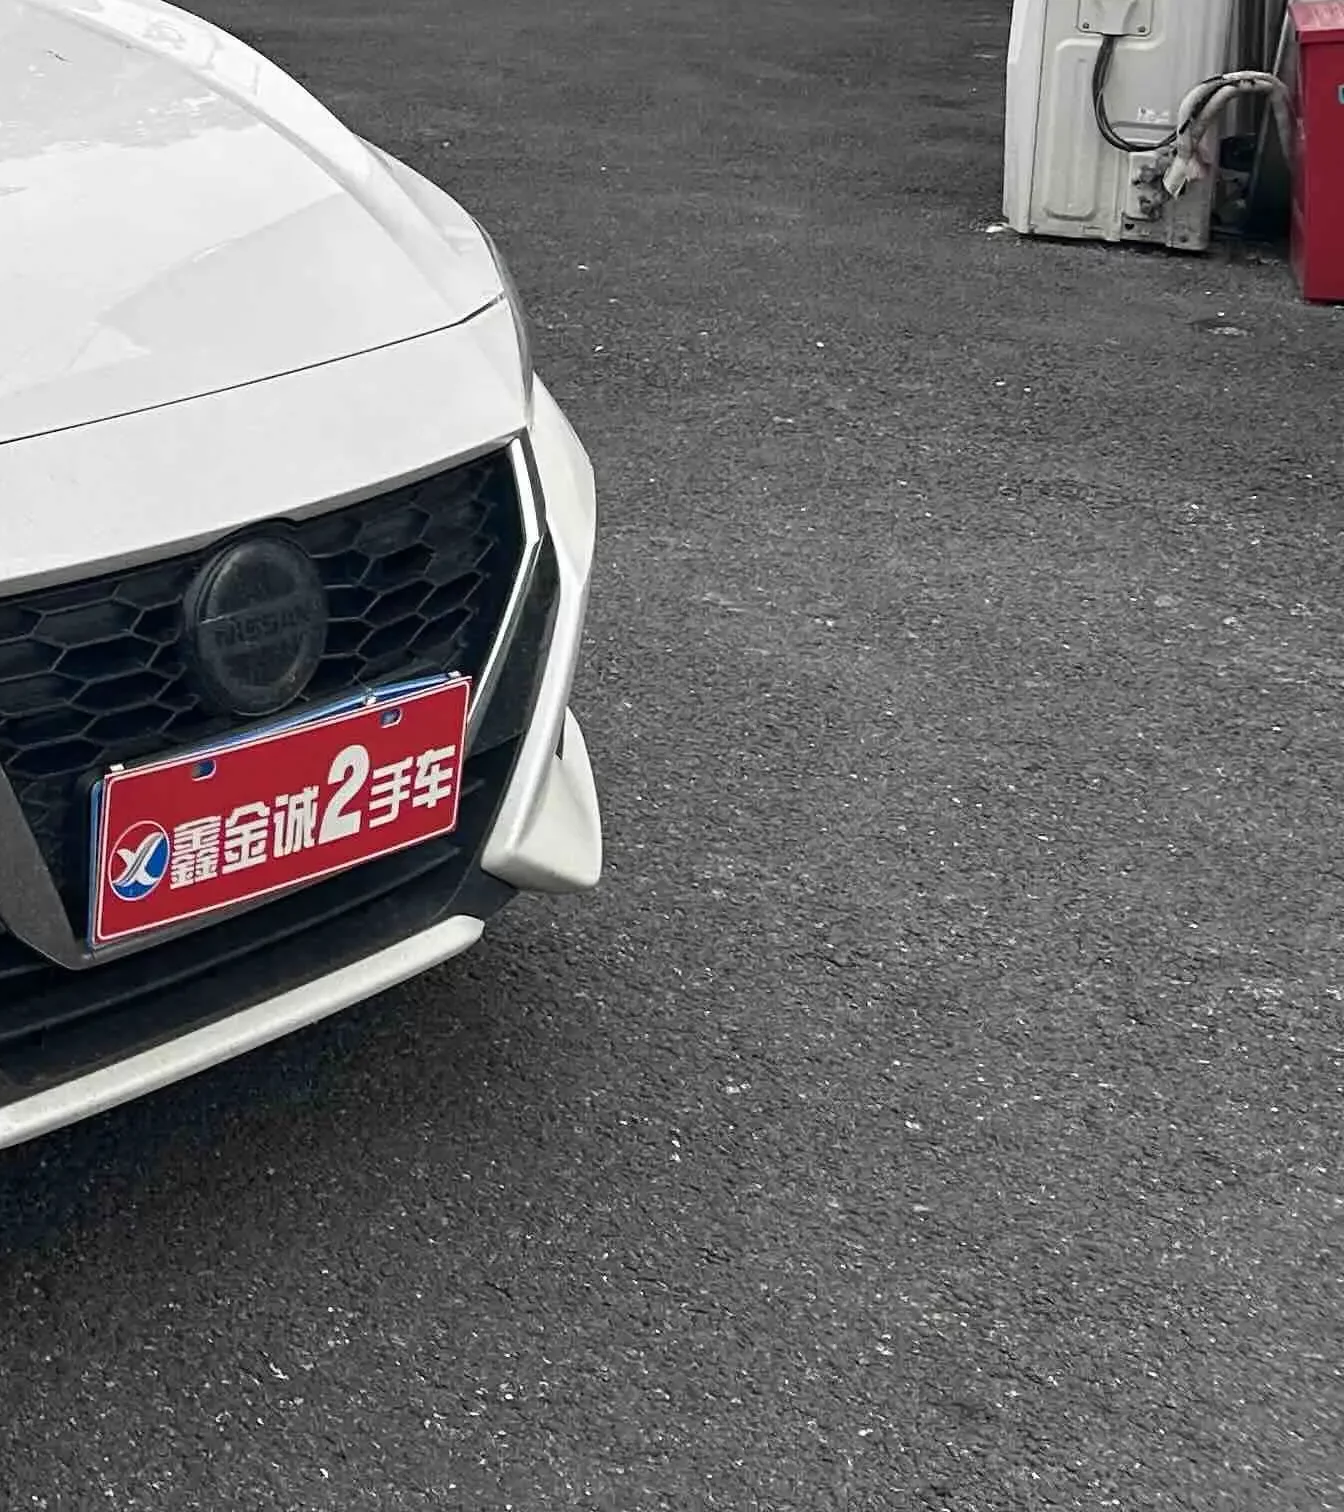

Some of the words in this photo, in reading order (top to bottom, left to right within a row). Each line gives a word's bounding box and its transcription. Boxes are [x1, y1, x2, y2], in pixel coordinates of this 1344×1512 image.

[169, 744, 456, 890] 鑫金诚2手车
